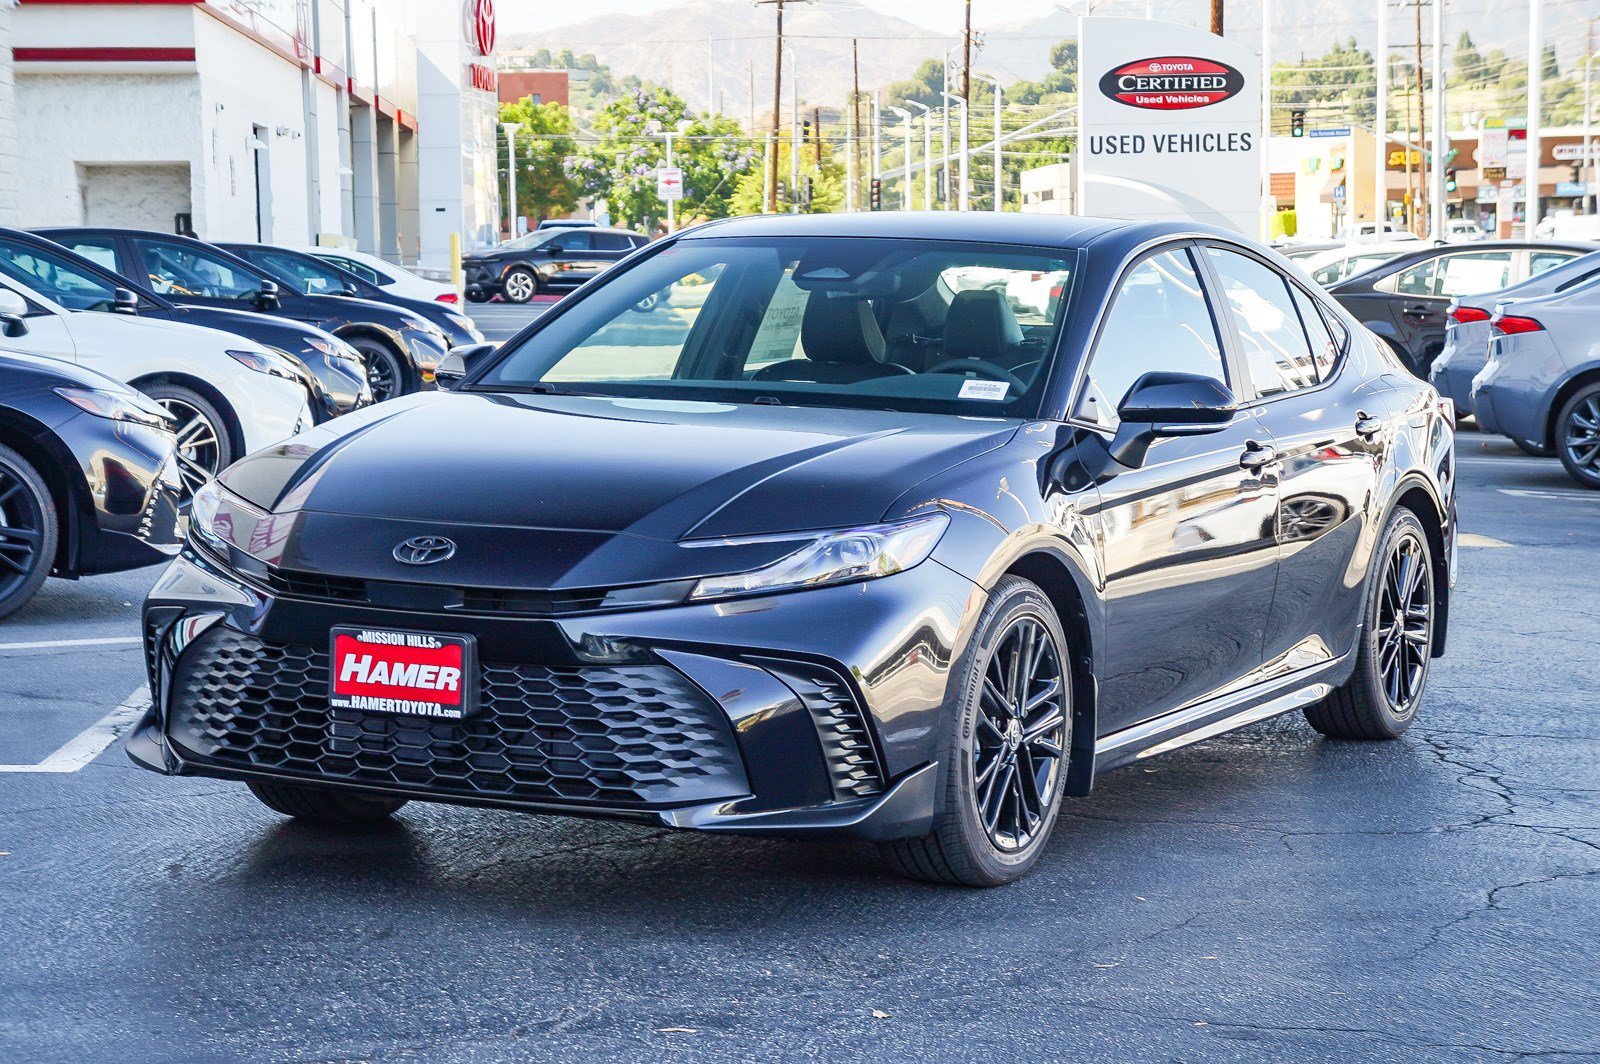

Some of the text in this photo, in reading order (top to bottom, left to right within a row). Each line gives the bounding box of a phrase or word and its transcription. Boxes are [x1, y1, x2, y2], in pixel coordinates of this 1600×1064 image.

[1161, 63, 1194, 71] TOYOTA
[1118, 75, 1227, 91] CERTIFIED
[1136, 95, 1209, 104] Used Vehicles
[1090, 132, 1252, 155] USED VEHICLES
[362, 630, 436, 649] MISSION HILLS
[339, 653, 461, 691] HAMER
[331, 695, 461, 719] www.HAMERTOYOTA.com
